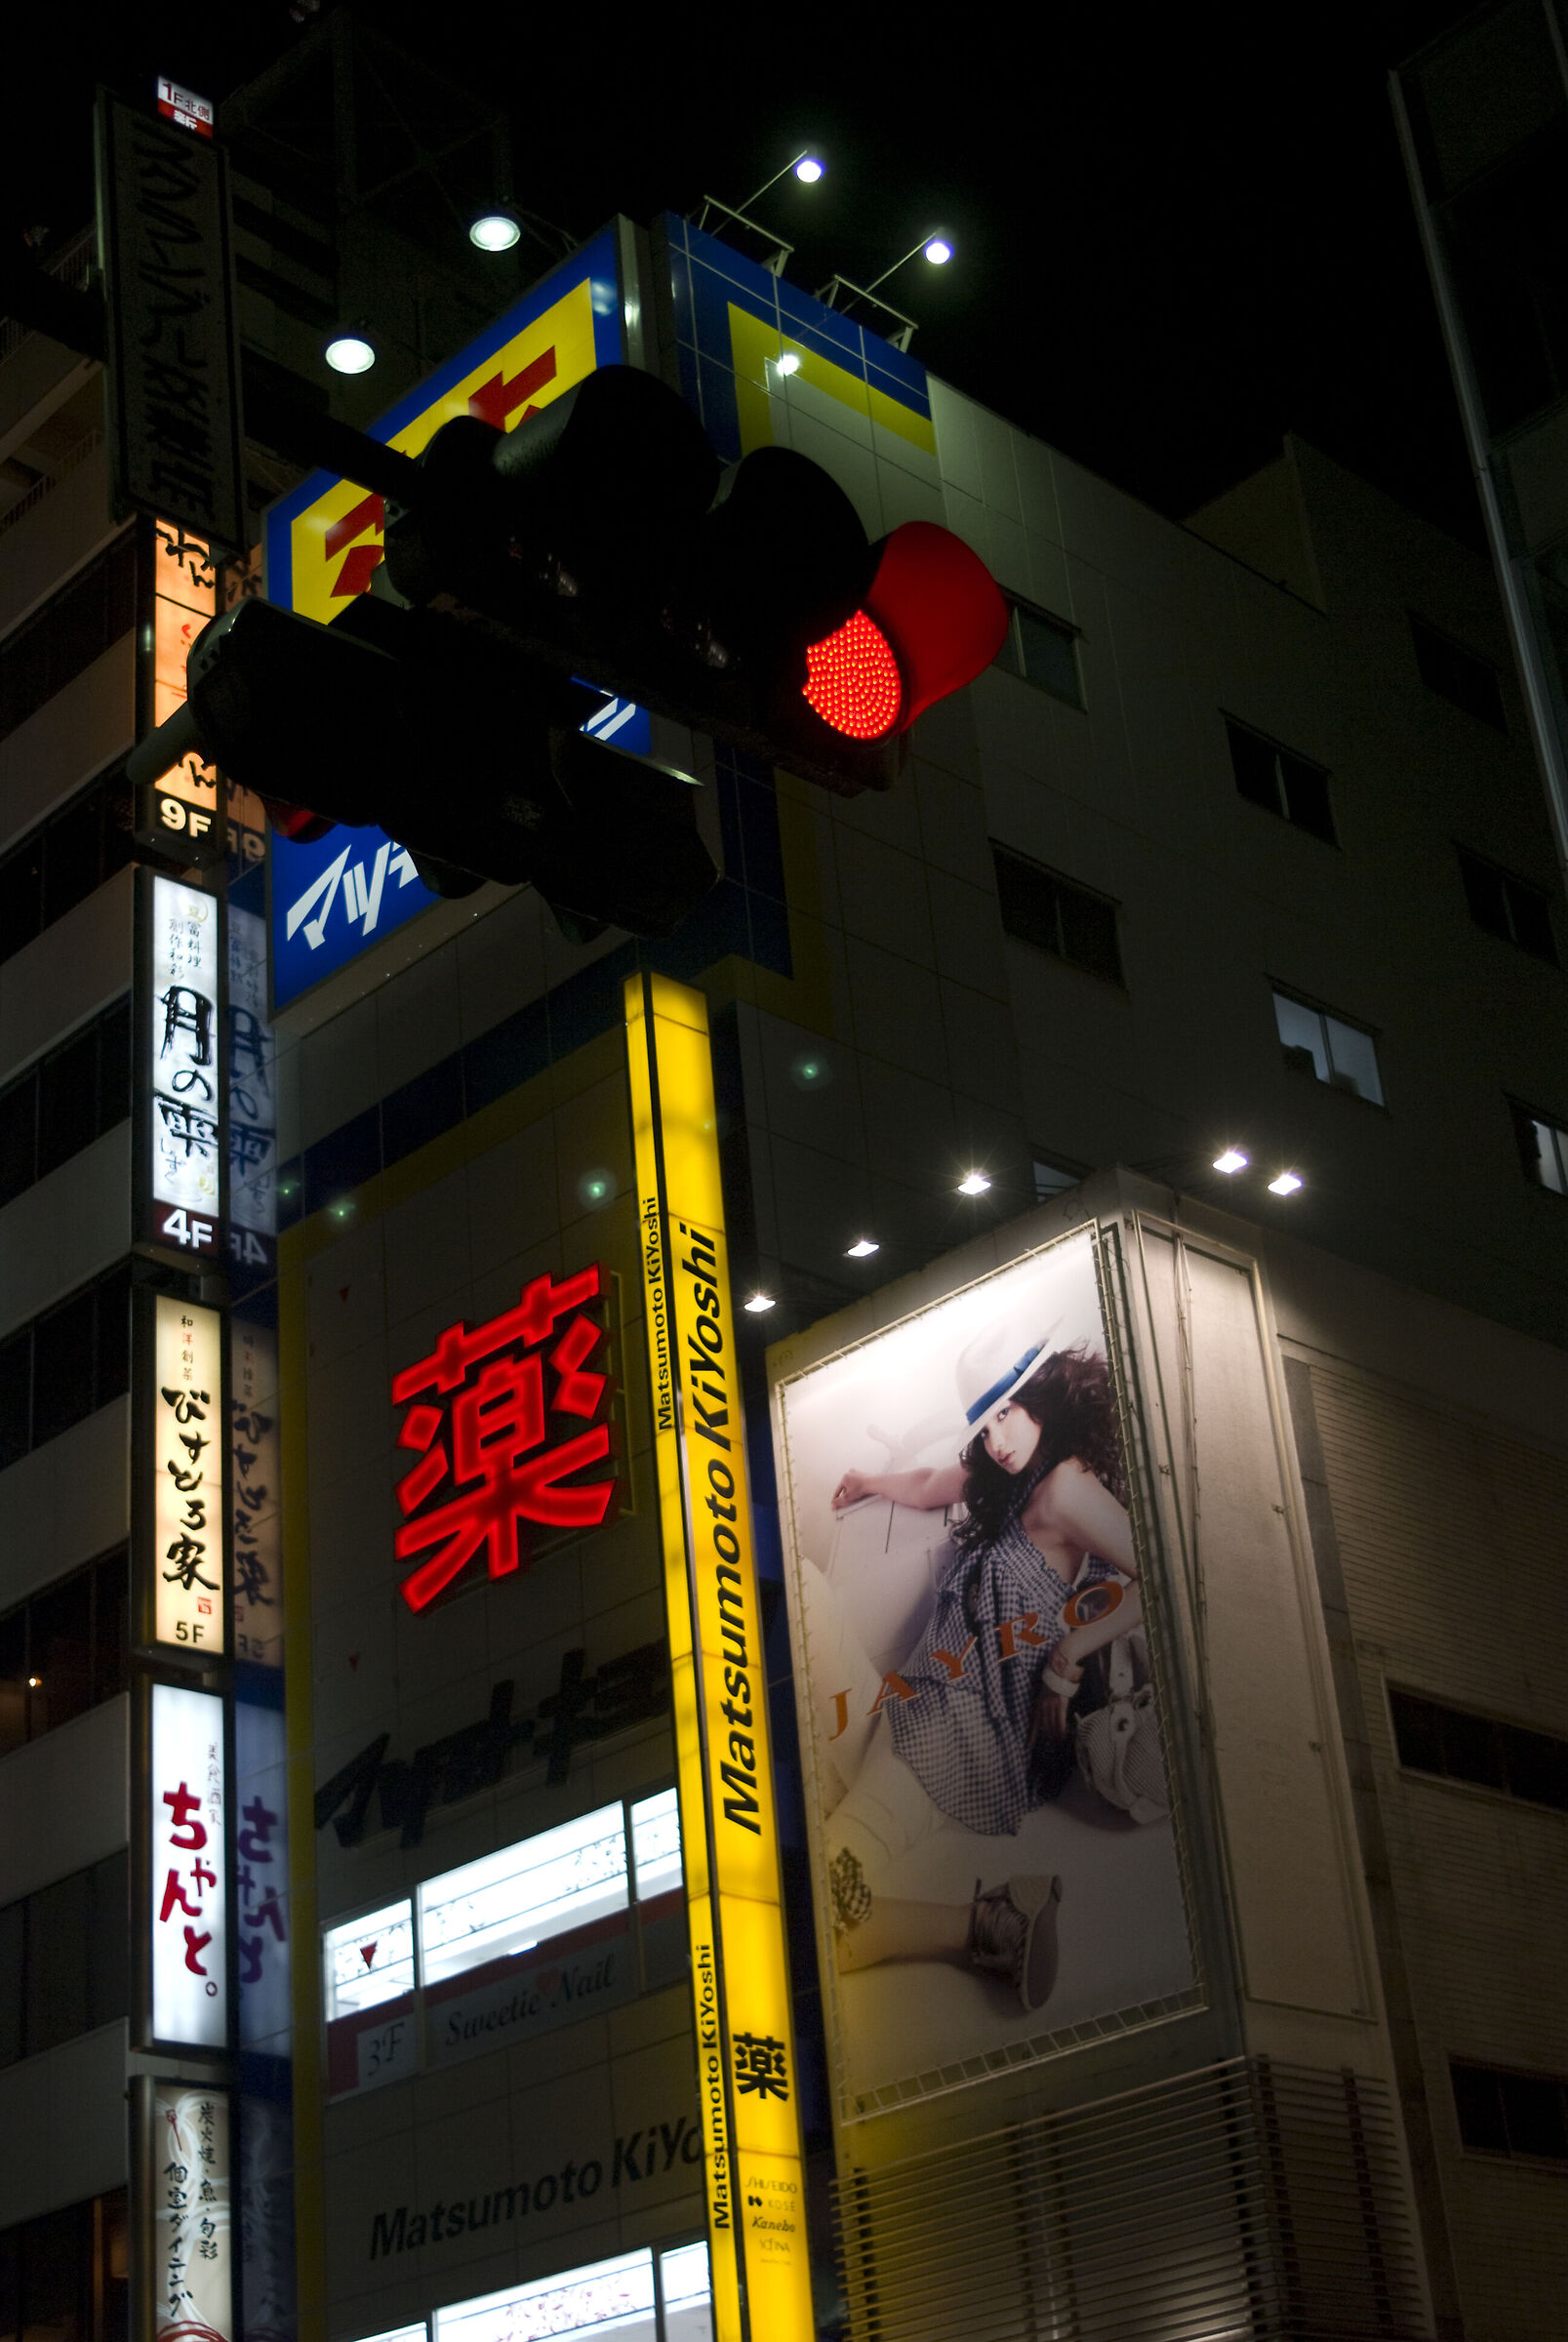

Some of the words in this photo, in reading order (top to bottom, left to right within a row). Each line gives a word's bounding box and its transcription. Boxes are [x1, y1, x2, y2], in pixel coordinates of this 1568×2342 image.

[160, 797, 212, 838] 9F
[153, 986, 219, 1158] 月の雫
[162, 1209, 213, 1250] 4F
[642, 1196, 664, 1285] KiYoshi
[651, 1287, 673, 1432] Matsumoto
[679, 1222, 733, 1452] KiYoshi
[161, 1386, 221, 1592] びすとろ家
[391, 1261, 617, 1615] 薬
[175, 1620, 205, 1644] 5F
[704, 1458, 762, 1837] Matsumoto
[828, 1580, 1124, 1743] JAYRO
[696, 1944, 717, 2049] KiYoshi
[733, 2032, 789, 2102] 薬
[707, 2054, 730, 2230] Matsumoto
[369, 2158, 603, 2260] Matsumoto
[751, 2216, 796, 2233] Kanebo
